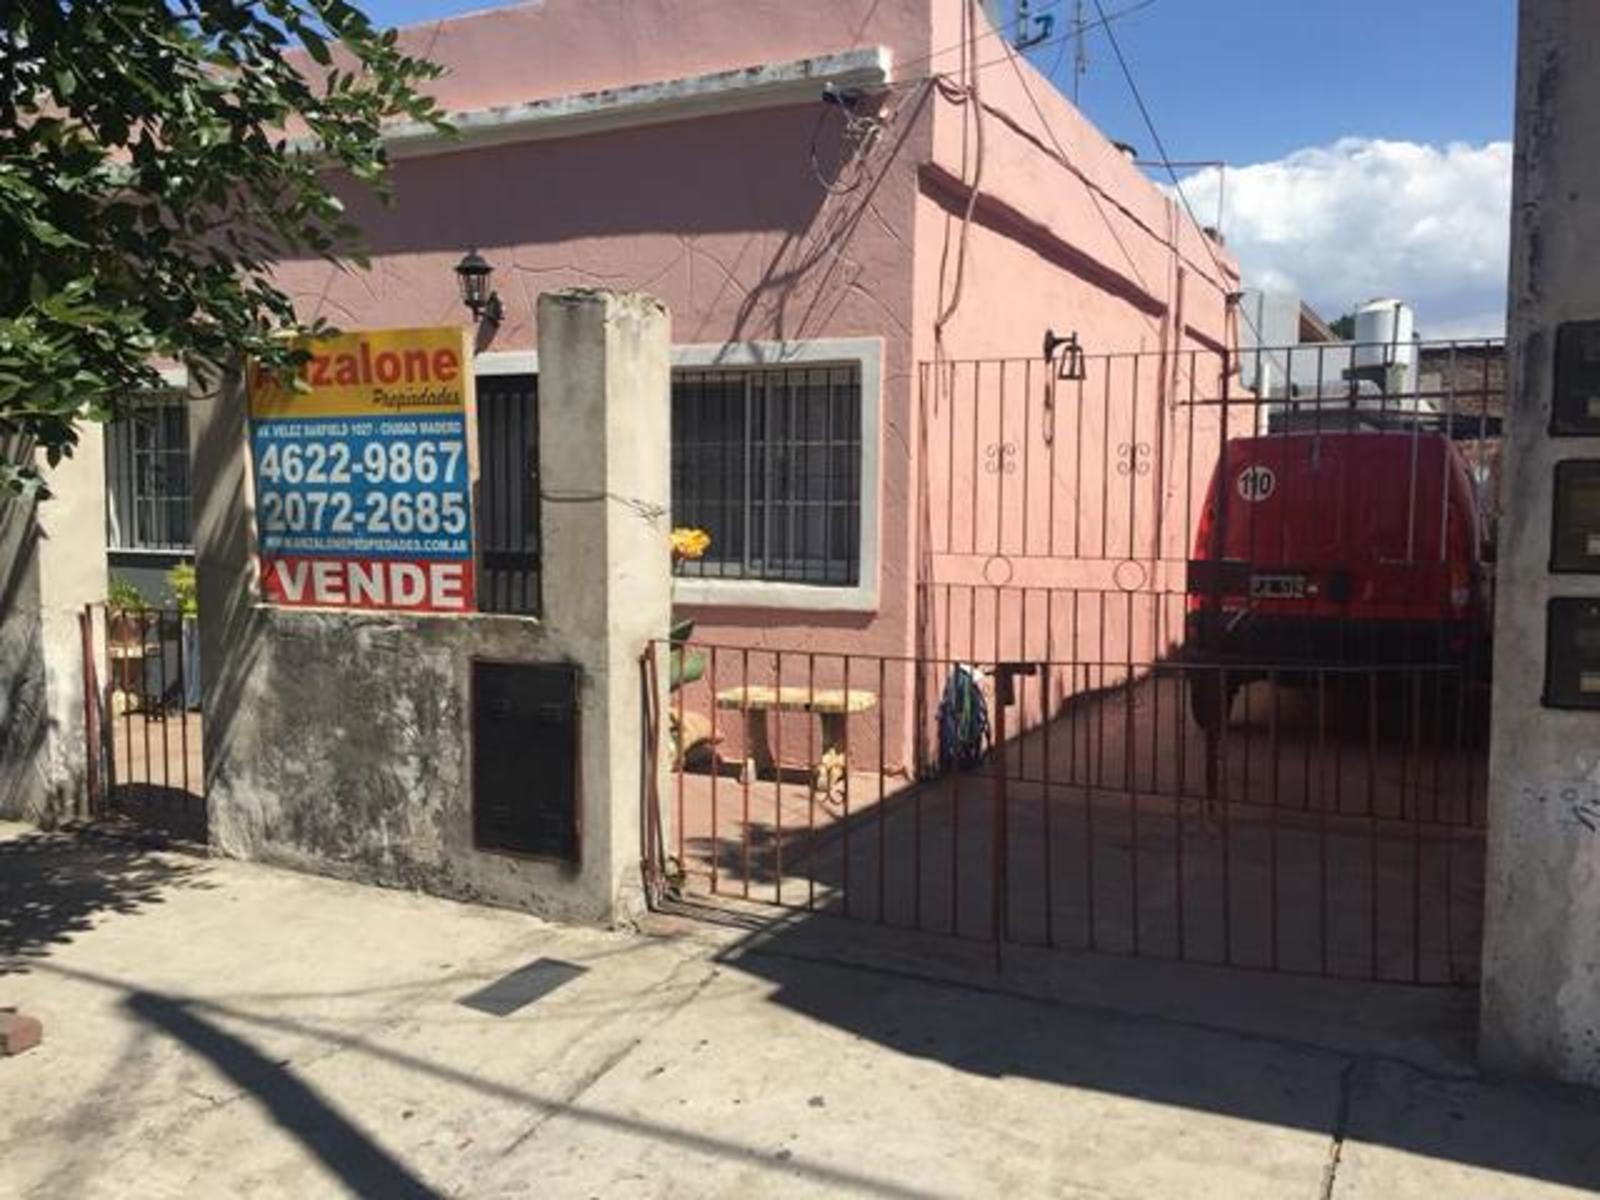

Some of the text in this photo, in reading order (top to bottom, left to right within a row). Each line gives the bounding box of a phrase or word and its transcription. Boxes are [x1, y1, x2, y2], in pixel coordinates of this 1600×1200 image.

[271, 424, 301, 438] VELEZ
[380, 421, 418, 435] CIUDAD
[419, 421, 462, 434] MADERO
[259, 441, 463, 484] 4622-9867
[1240, 471, 1271, 495] 110
[262, 491, 467, 534] 2072-2685
[274, 560, 464, 607] VENDE
